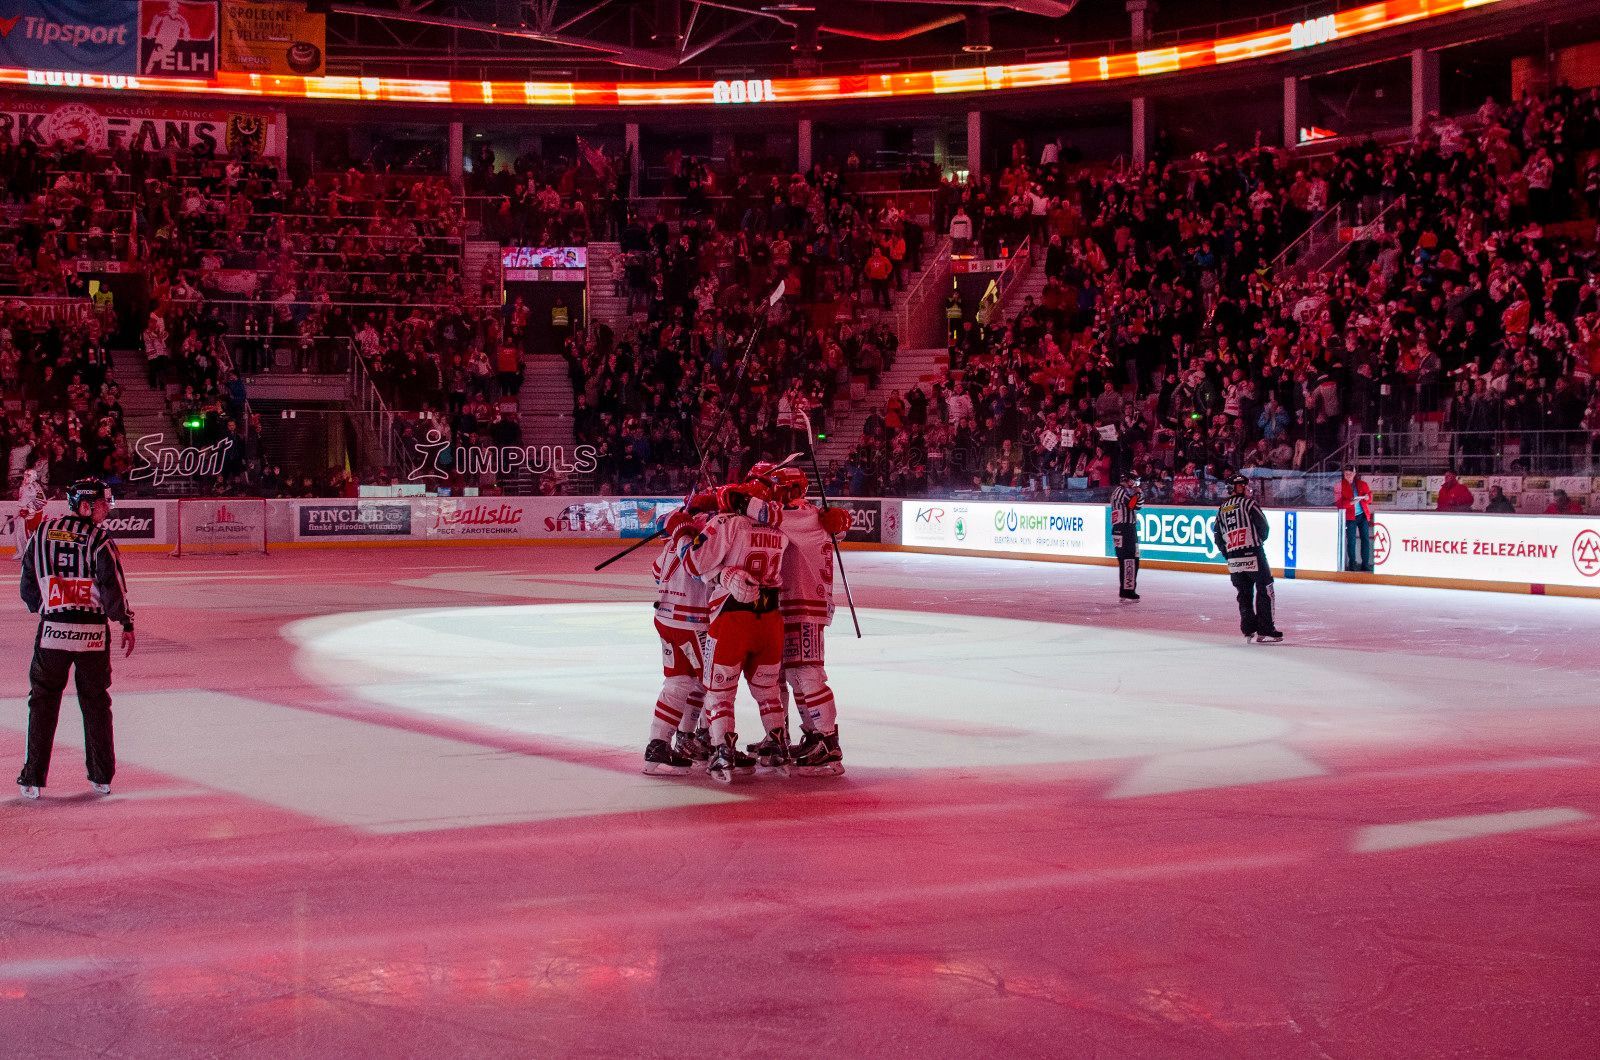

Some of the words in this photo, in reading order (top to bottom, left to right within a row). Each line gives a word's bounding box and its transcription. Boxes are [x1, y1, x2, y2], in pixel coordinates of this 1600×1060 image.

[25, 16, 127, 48] Tipsport
[161, 51, 209, 72] ELH
[713, 79, 777, 103] GOOL
[107, 117, 217, 152] FANS
[129, 432, 234, 486] Sport
[456, 444, 598, 475] IMPULS
[100, 515, 153, 531] sostar
[308, 509, 384, 523] FINCLUB
[850, 508, 878, 533] GAST
[915, 507, 946, 523] KR
[1019, 515, 1048, 530] RIGHT
[1050, 516, 1084, 532] POWER
[1227, 516, 1236, 525] 26
[750, 532, 783, 549] KINDL
[1135, 512, 1219, 553] ADEGAS
[1401, 536, 1468, 555] TŘINECKÉ
[1472, 539, 1558, 558] ŽELEZÁRNY
[58, 553, 75, 567] 51
[43, 626, 103, 641] Prostamol
